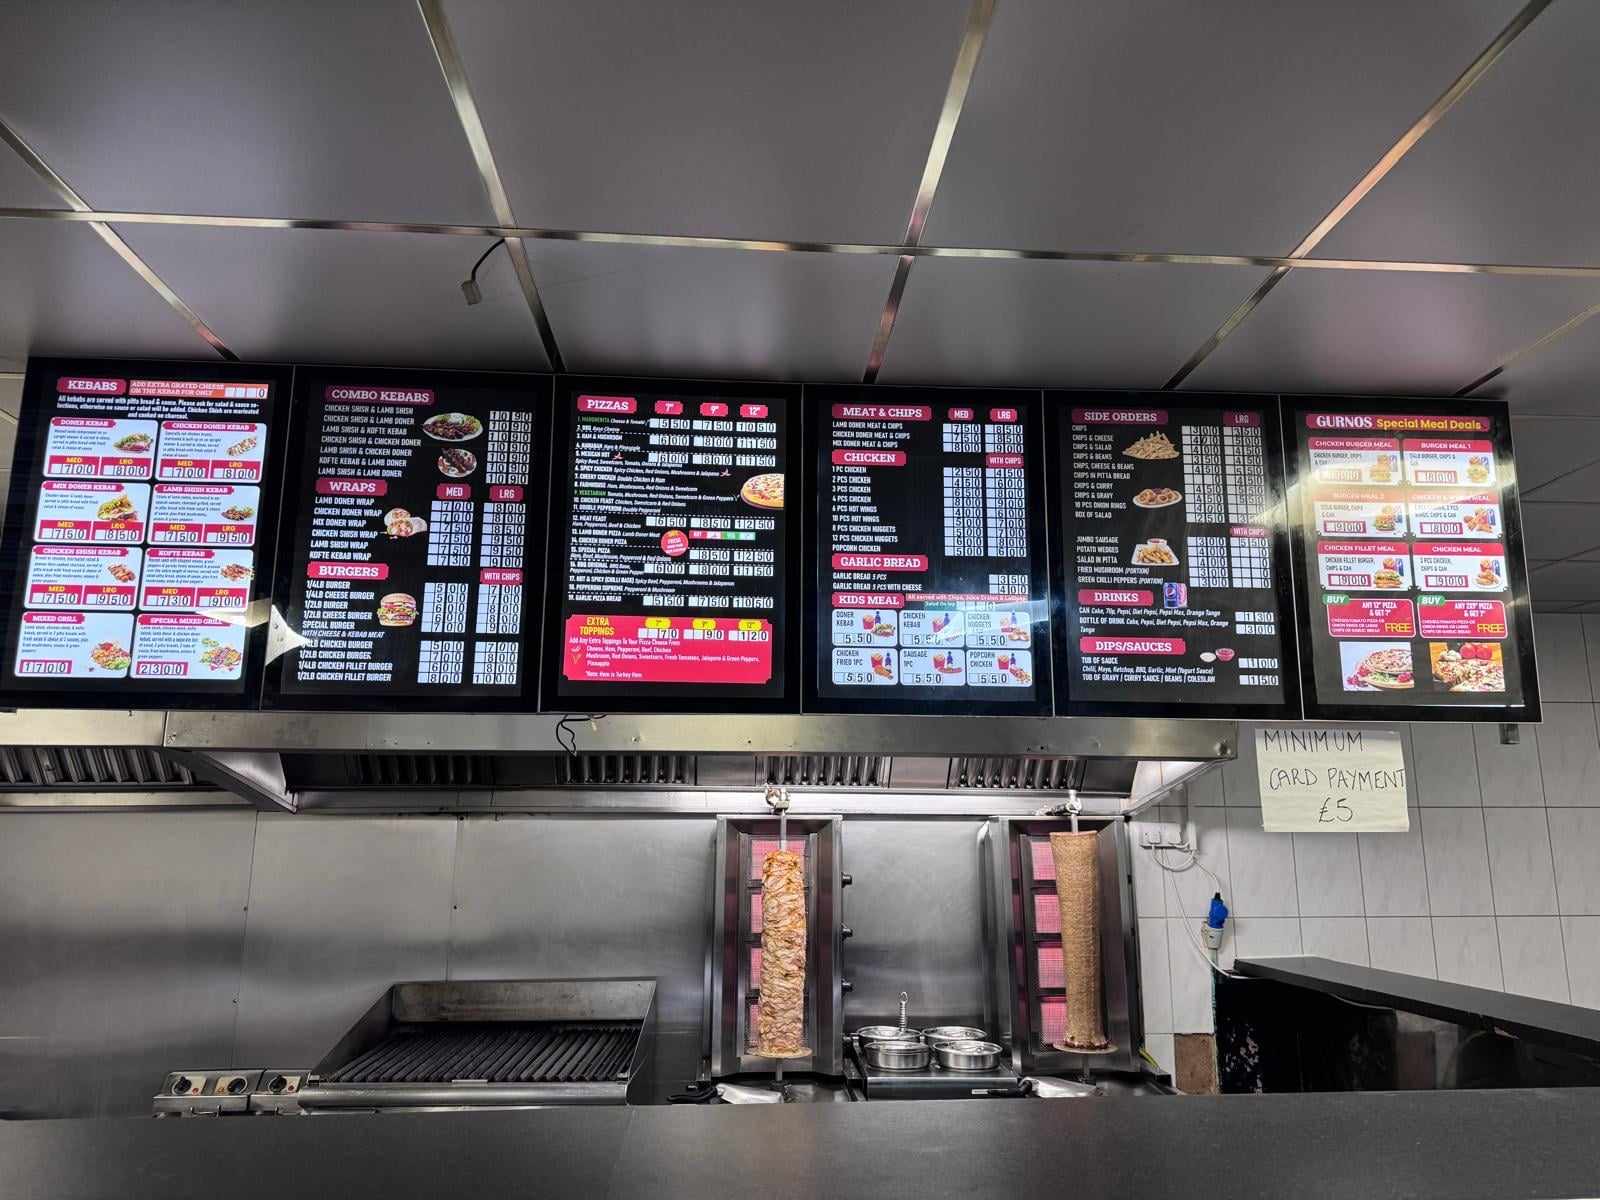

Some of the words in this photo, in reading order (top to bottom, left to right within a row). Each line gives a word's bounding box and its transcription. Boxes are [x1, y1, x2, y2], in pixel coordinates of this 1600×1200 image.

[68, 380, 117, 391] KEBABS
[332, 391, 377, 400] COMBO
[380, 392, 429, 402] KEBABS
[587, 400, 629, 410] PIZZAS
[843, 408, 877, 416] MEAT
[890, 409, 922, 417] CHIPS
[955, 410, 968, 419] MED
[997, 411, 1010, 419] LRG
[1085, 412, 1109, 421] SIDE
[1113, 413, 1157, 422] ORDERS
[1317, 416, 1372, 428] GURNOS
[1376, 419, 1418, 430] Special
[1420, 420, 1447, 429] Meal
[1450, 420, 1481, 430] Deals
[844, 453, 895, 463] CHICKEN
[330, 482, 375, 492] WRAPS
[447, 488, 463, 496] MED
[499, 490, 515, 498] LRG
[340, 530, 357, 538] SHISH
[359, 531, 378, 539] WRAP
[841, 557, 881, 567] GARLIC
[883, 557, 920, 568] BREAD
[319, 567, 379, 577] BURGERS
[839, 596, 865, 604] KIDS
[867, 596, 899, 605] MEAL
[1095, 593, 1138, 602] DRINKS
[587, 617, 609, 626] EXTRA
[579, 627, 615, 636] TOPPINGS
[1385, 623, 1412, 632] FREE
[1477, 624, 1504, 633] FREE
[1096, 642, 1172, 651] DIPS/SAUCES
[1264, 730, 1363, 752] MINIMUM
[1270, 768, 1317, 790] CARD
[1328, 768, 1405, 791] PAYMENT
[1319, 797, 1353, 822] £5
